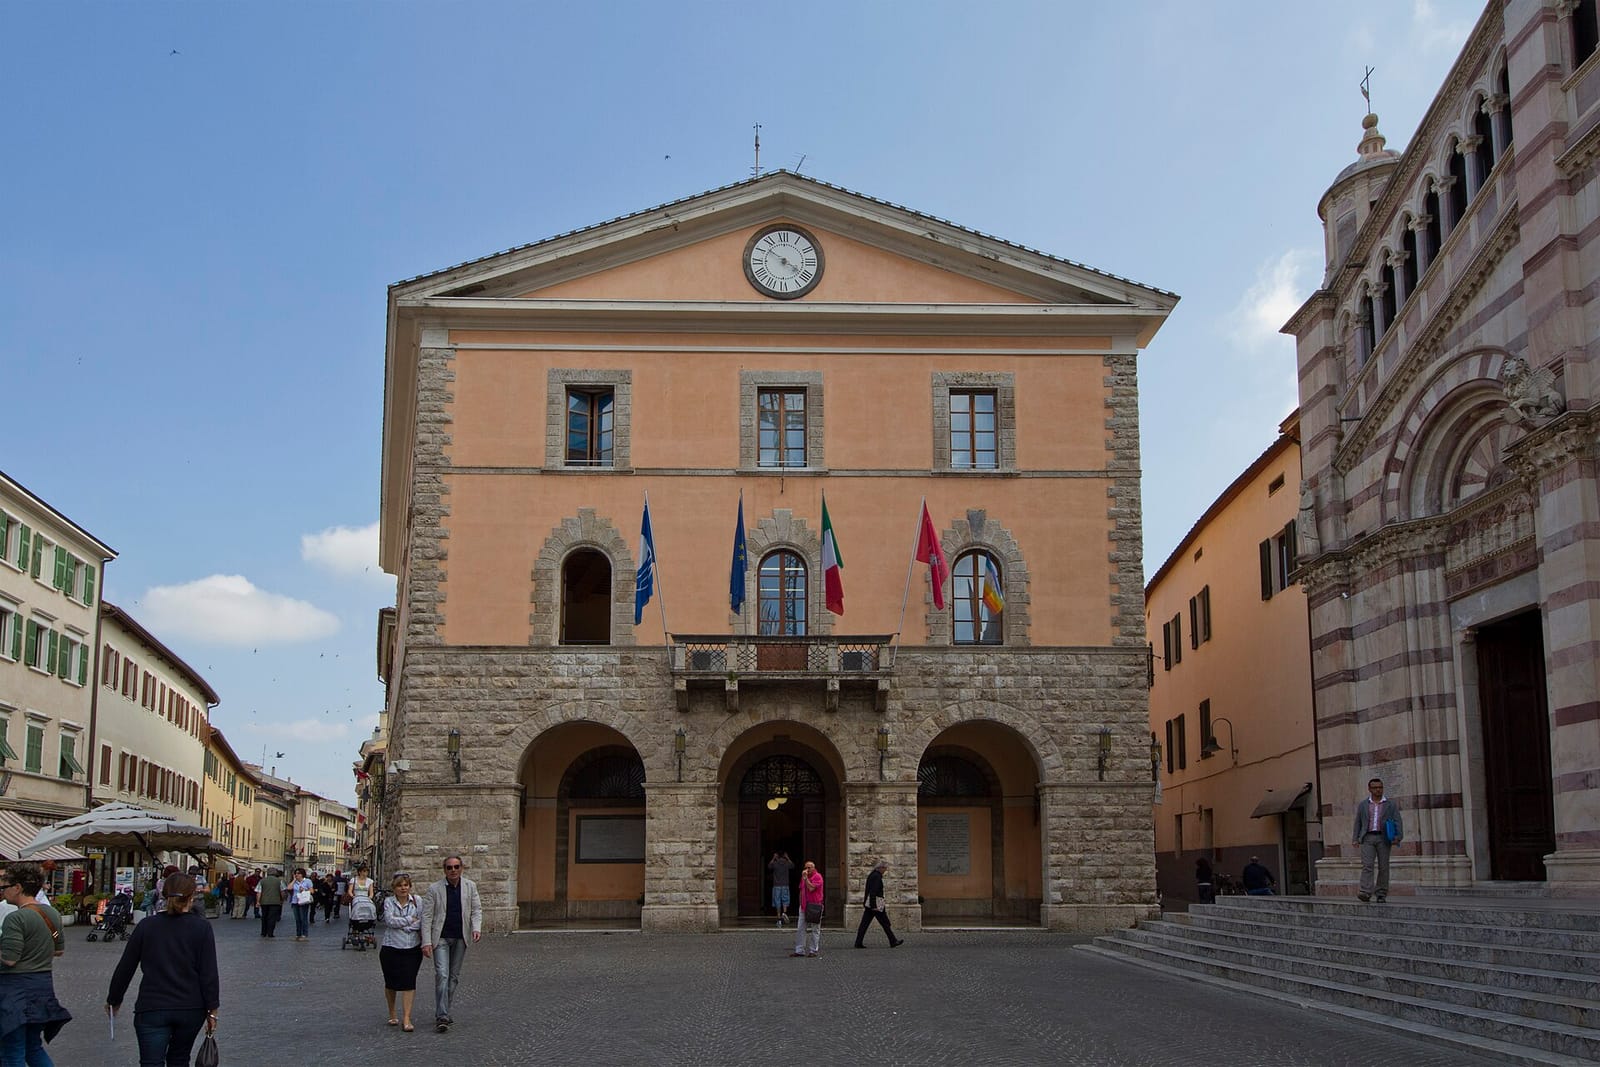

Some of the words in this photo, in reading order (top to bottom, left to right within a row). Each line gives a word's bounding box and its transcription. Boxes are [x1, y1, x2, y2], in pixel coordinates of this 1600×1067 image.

[777, 231, 789, 243] XII
[802, 246, 813, 254] II
[804, 258, 816, 267] III
